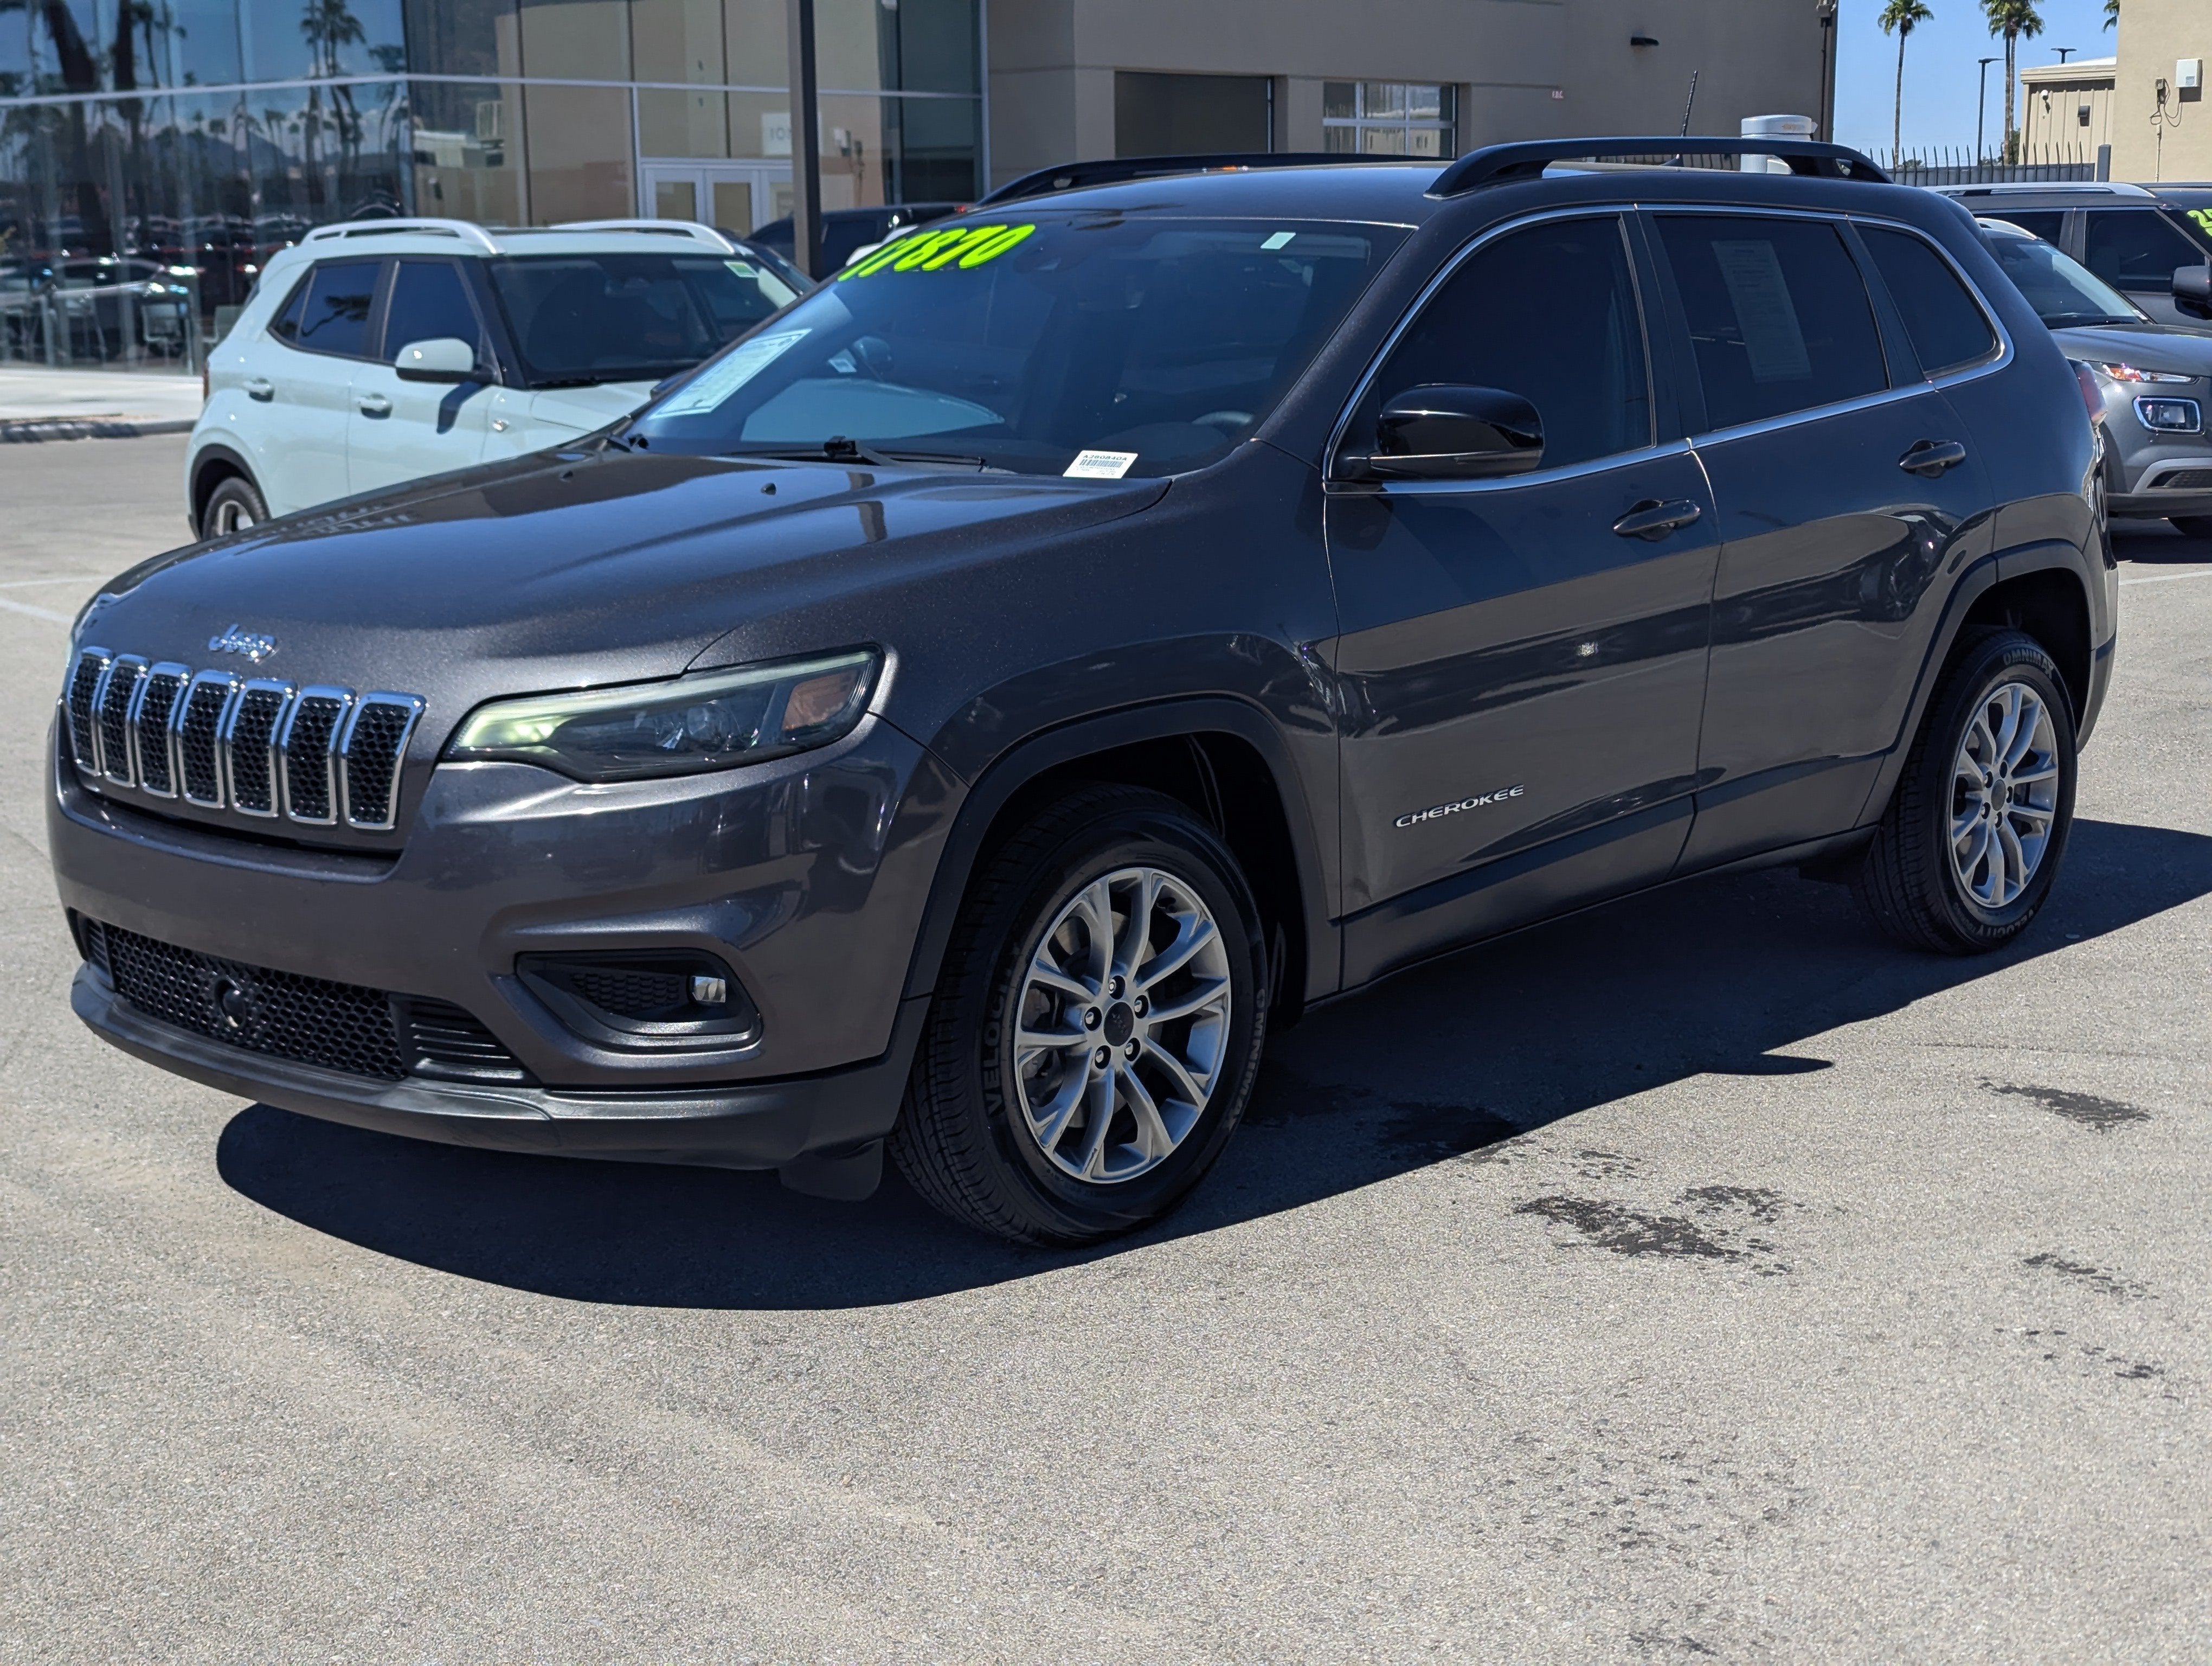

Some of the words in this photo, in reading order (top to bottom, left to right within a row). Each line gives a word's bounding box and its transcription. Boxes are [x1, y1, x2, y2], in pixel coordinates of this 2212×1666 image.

[837, 223, 1036, 282] 17870
[208, 623, 275, 663] Jeep
[2003, 649, 2054, 680] OMNIMAX
[1395, 784, 1525, 828] CHEROKEE
